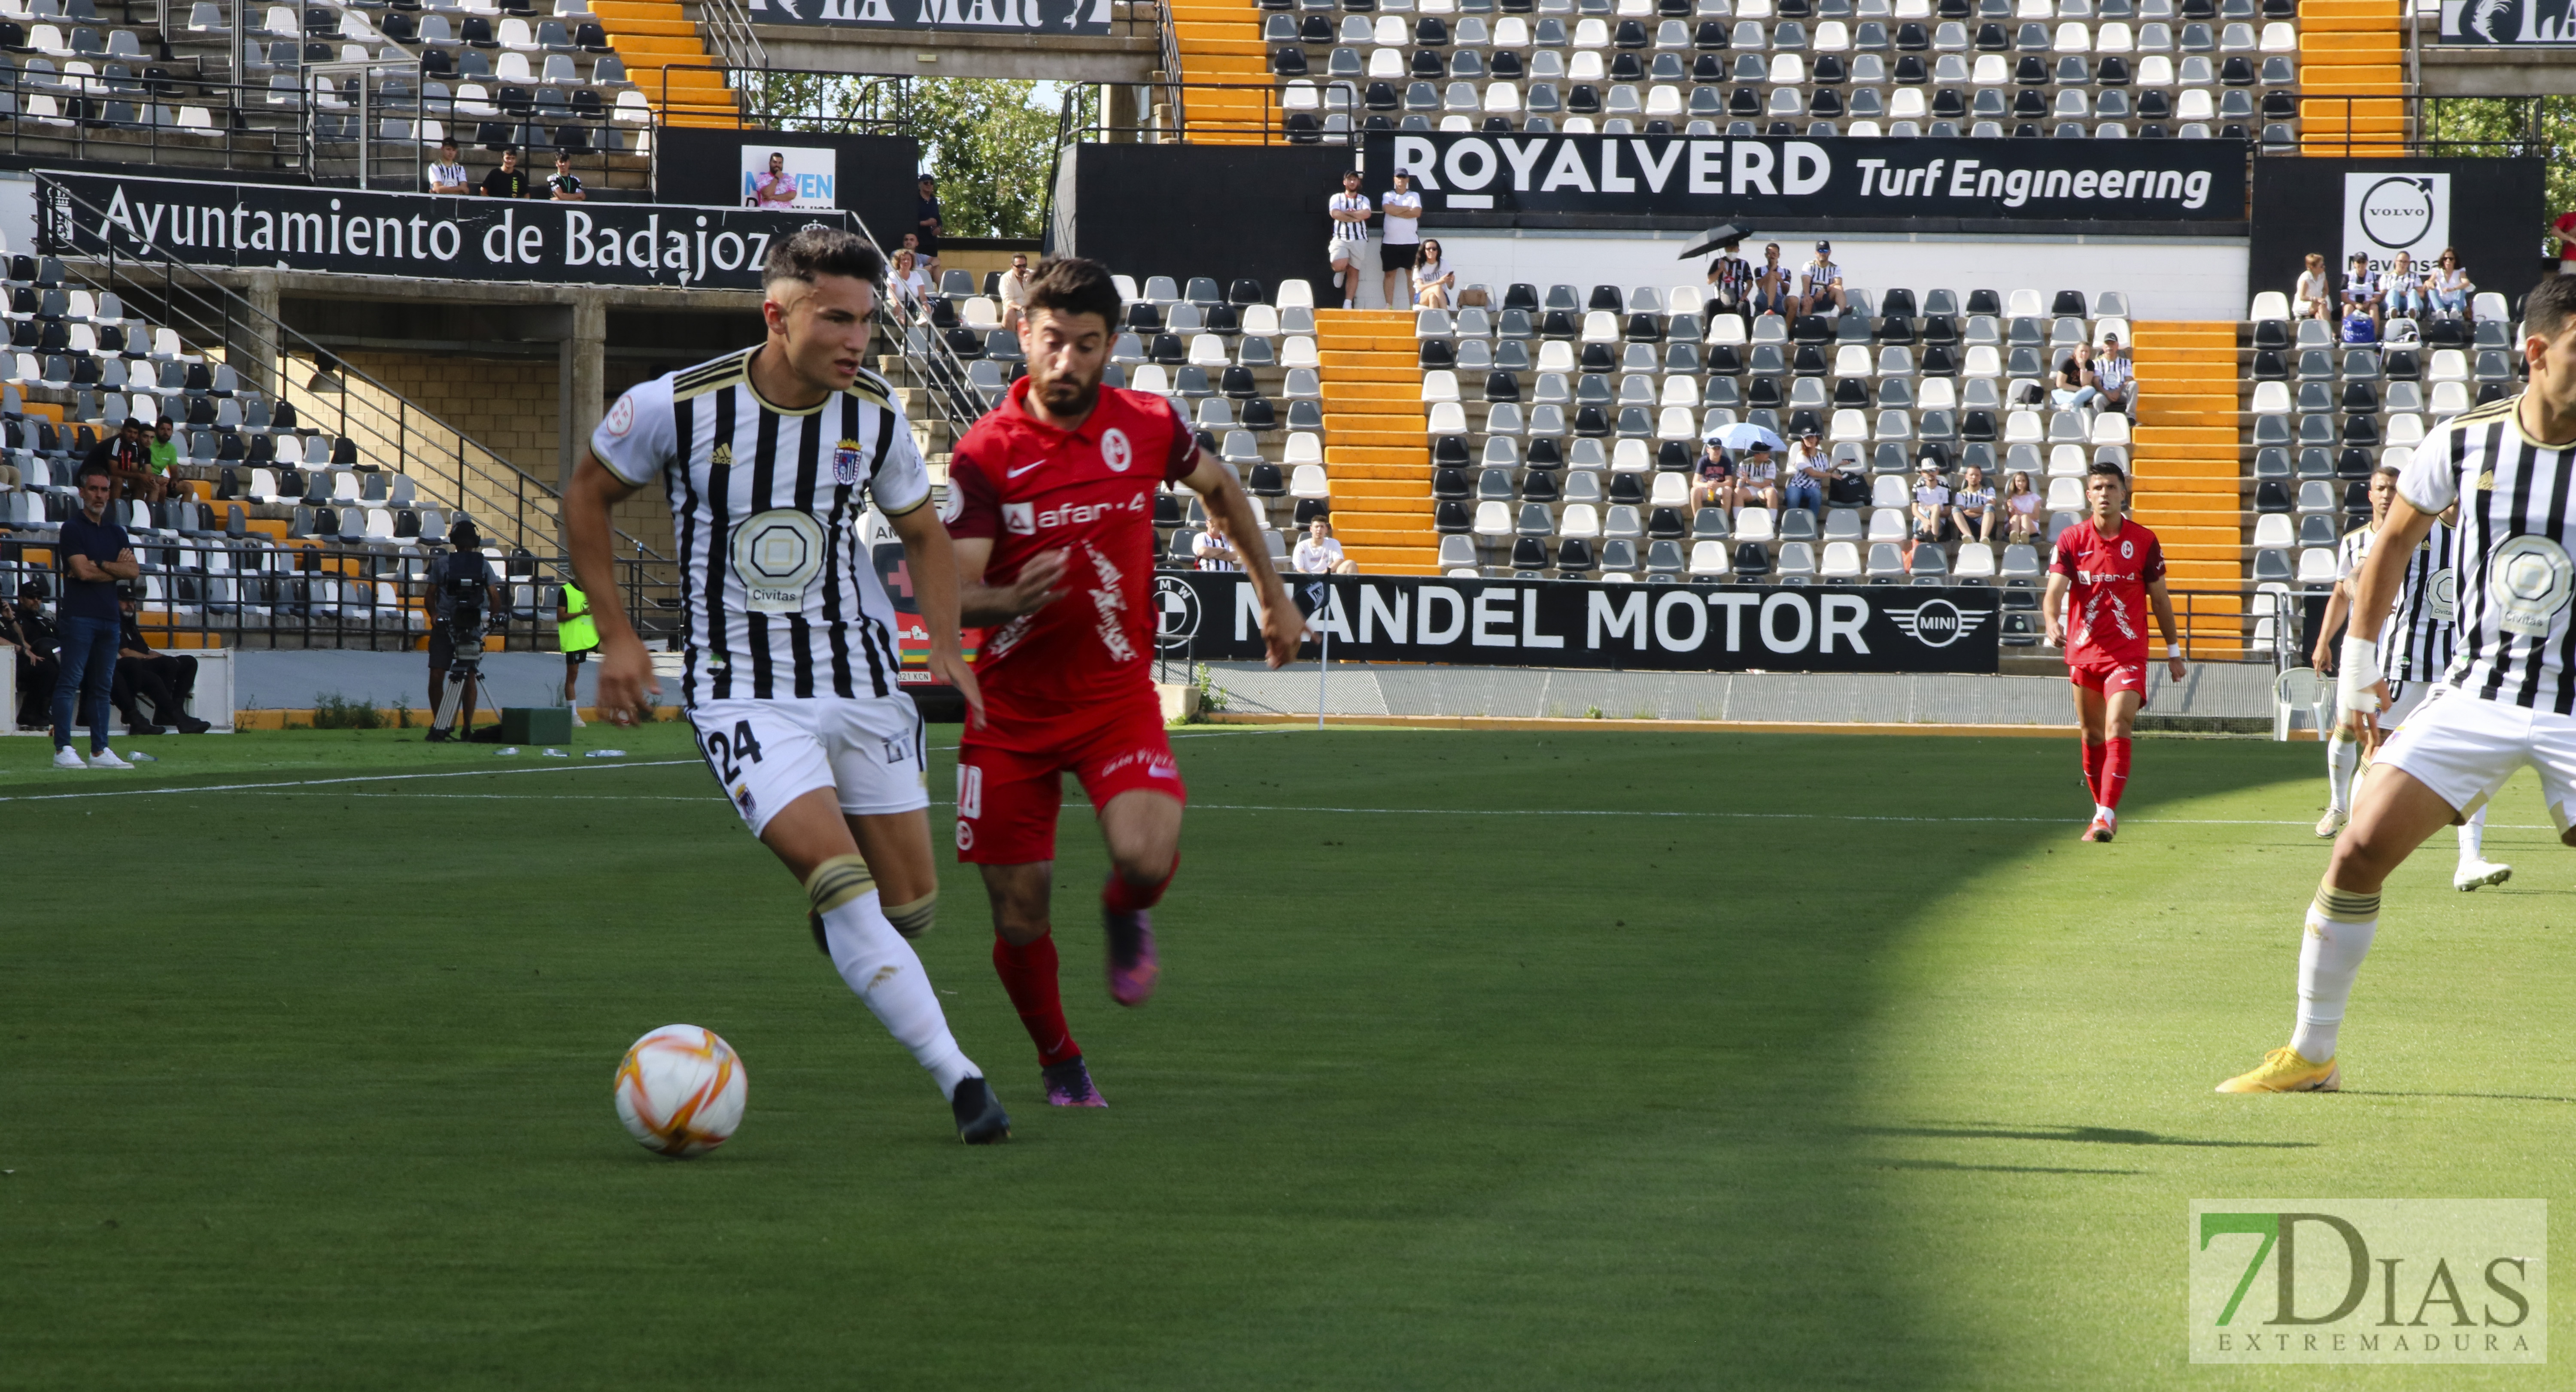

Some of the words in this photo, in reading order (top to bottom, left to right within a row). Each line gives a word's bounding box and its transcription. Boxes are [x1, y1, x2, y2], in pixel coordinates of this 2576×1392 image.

[1394, 136, 1831, 195] ROYALVERD
[1856, 159, 1944, 197] Turf
[1949, 160, 2211, 209] Engineering
[98, 184, 461, 261] Ayuntamiento
[483, 208, 543, 264] de
[565, 210, 771, 281] Badajoz
[753, 589, 796, 601] Civitas
[2505, 611, 2543, 627] Civitas
[1588, 591, 1870, 654] MOTOR
[1920, 617, 1956, 630] MINI
[914, 673, 929, 681] KCN
[708, 719, 763, 785] 24
